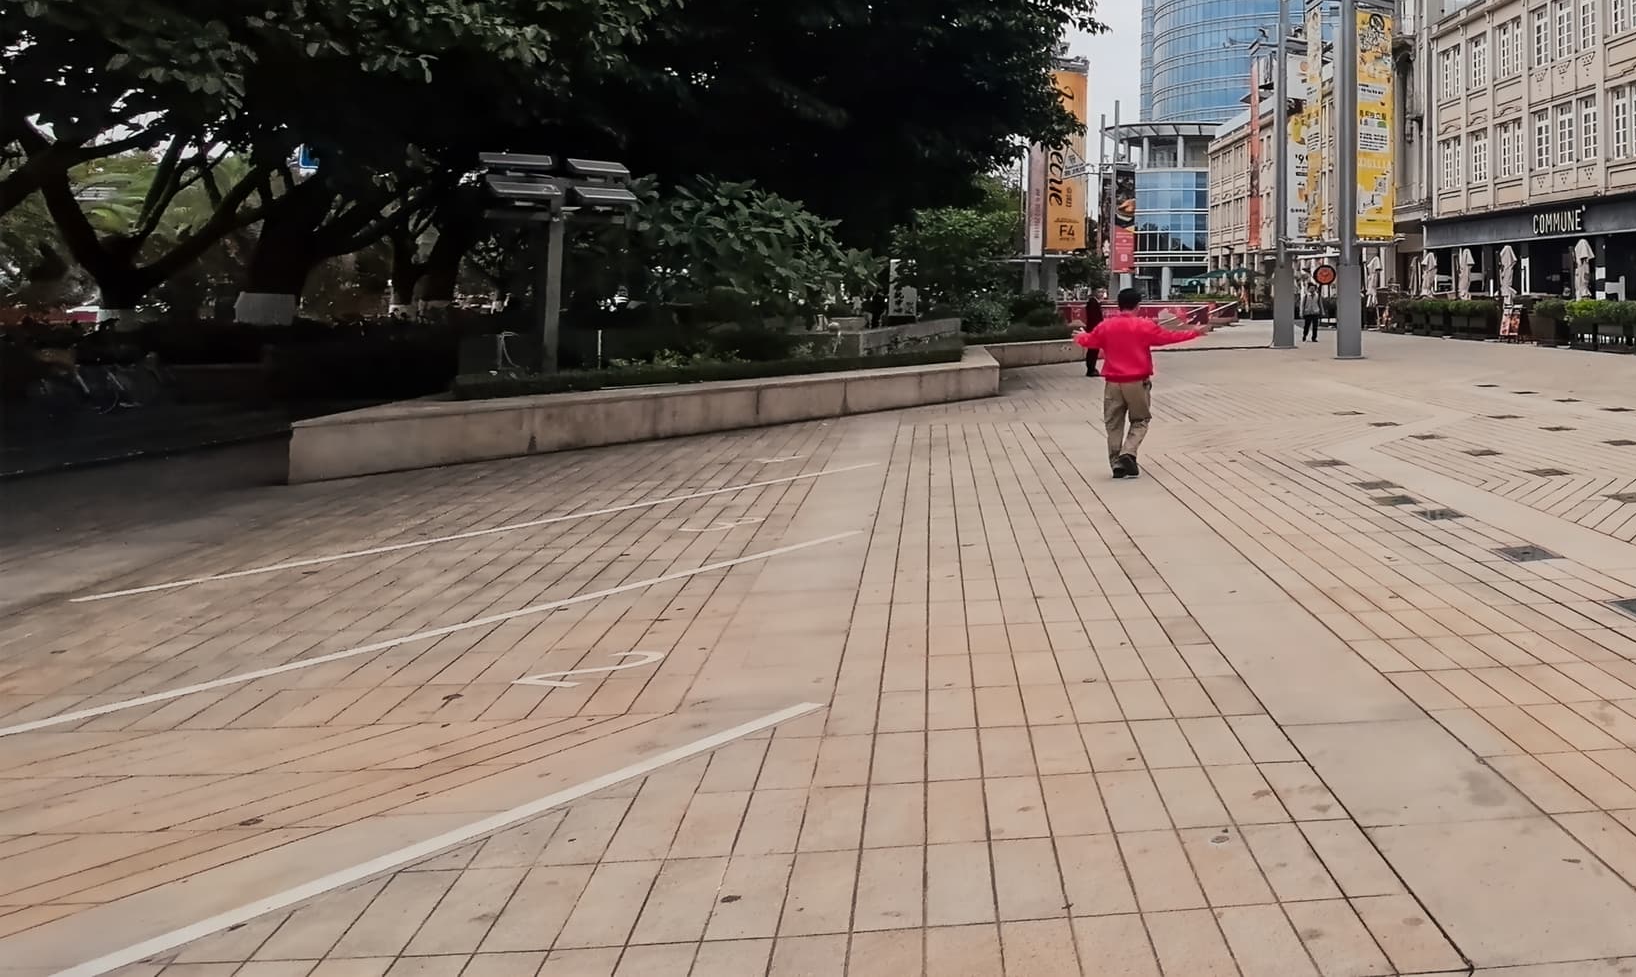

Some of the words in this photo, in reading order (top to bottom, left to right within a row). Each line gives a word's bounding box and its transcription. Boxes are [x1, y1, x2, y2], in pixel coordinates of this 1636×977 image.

[1059, 225, 1075, 237] F4
[1532, 209, 1583, 235] COMMUNE
[511, 649, 667, 689] 2
